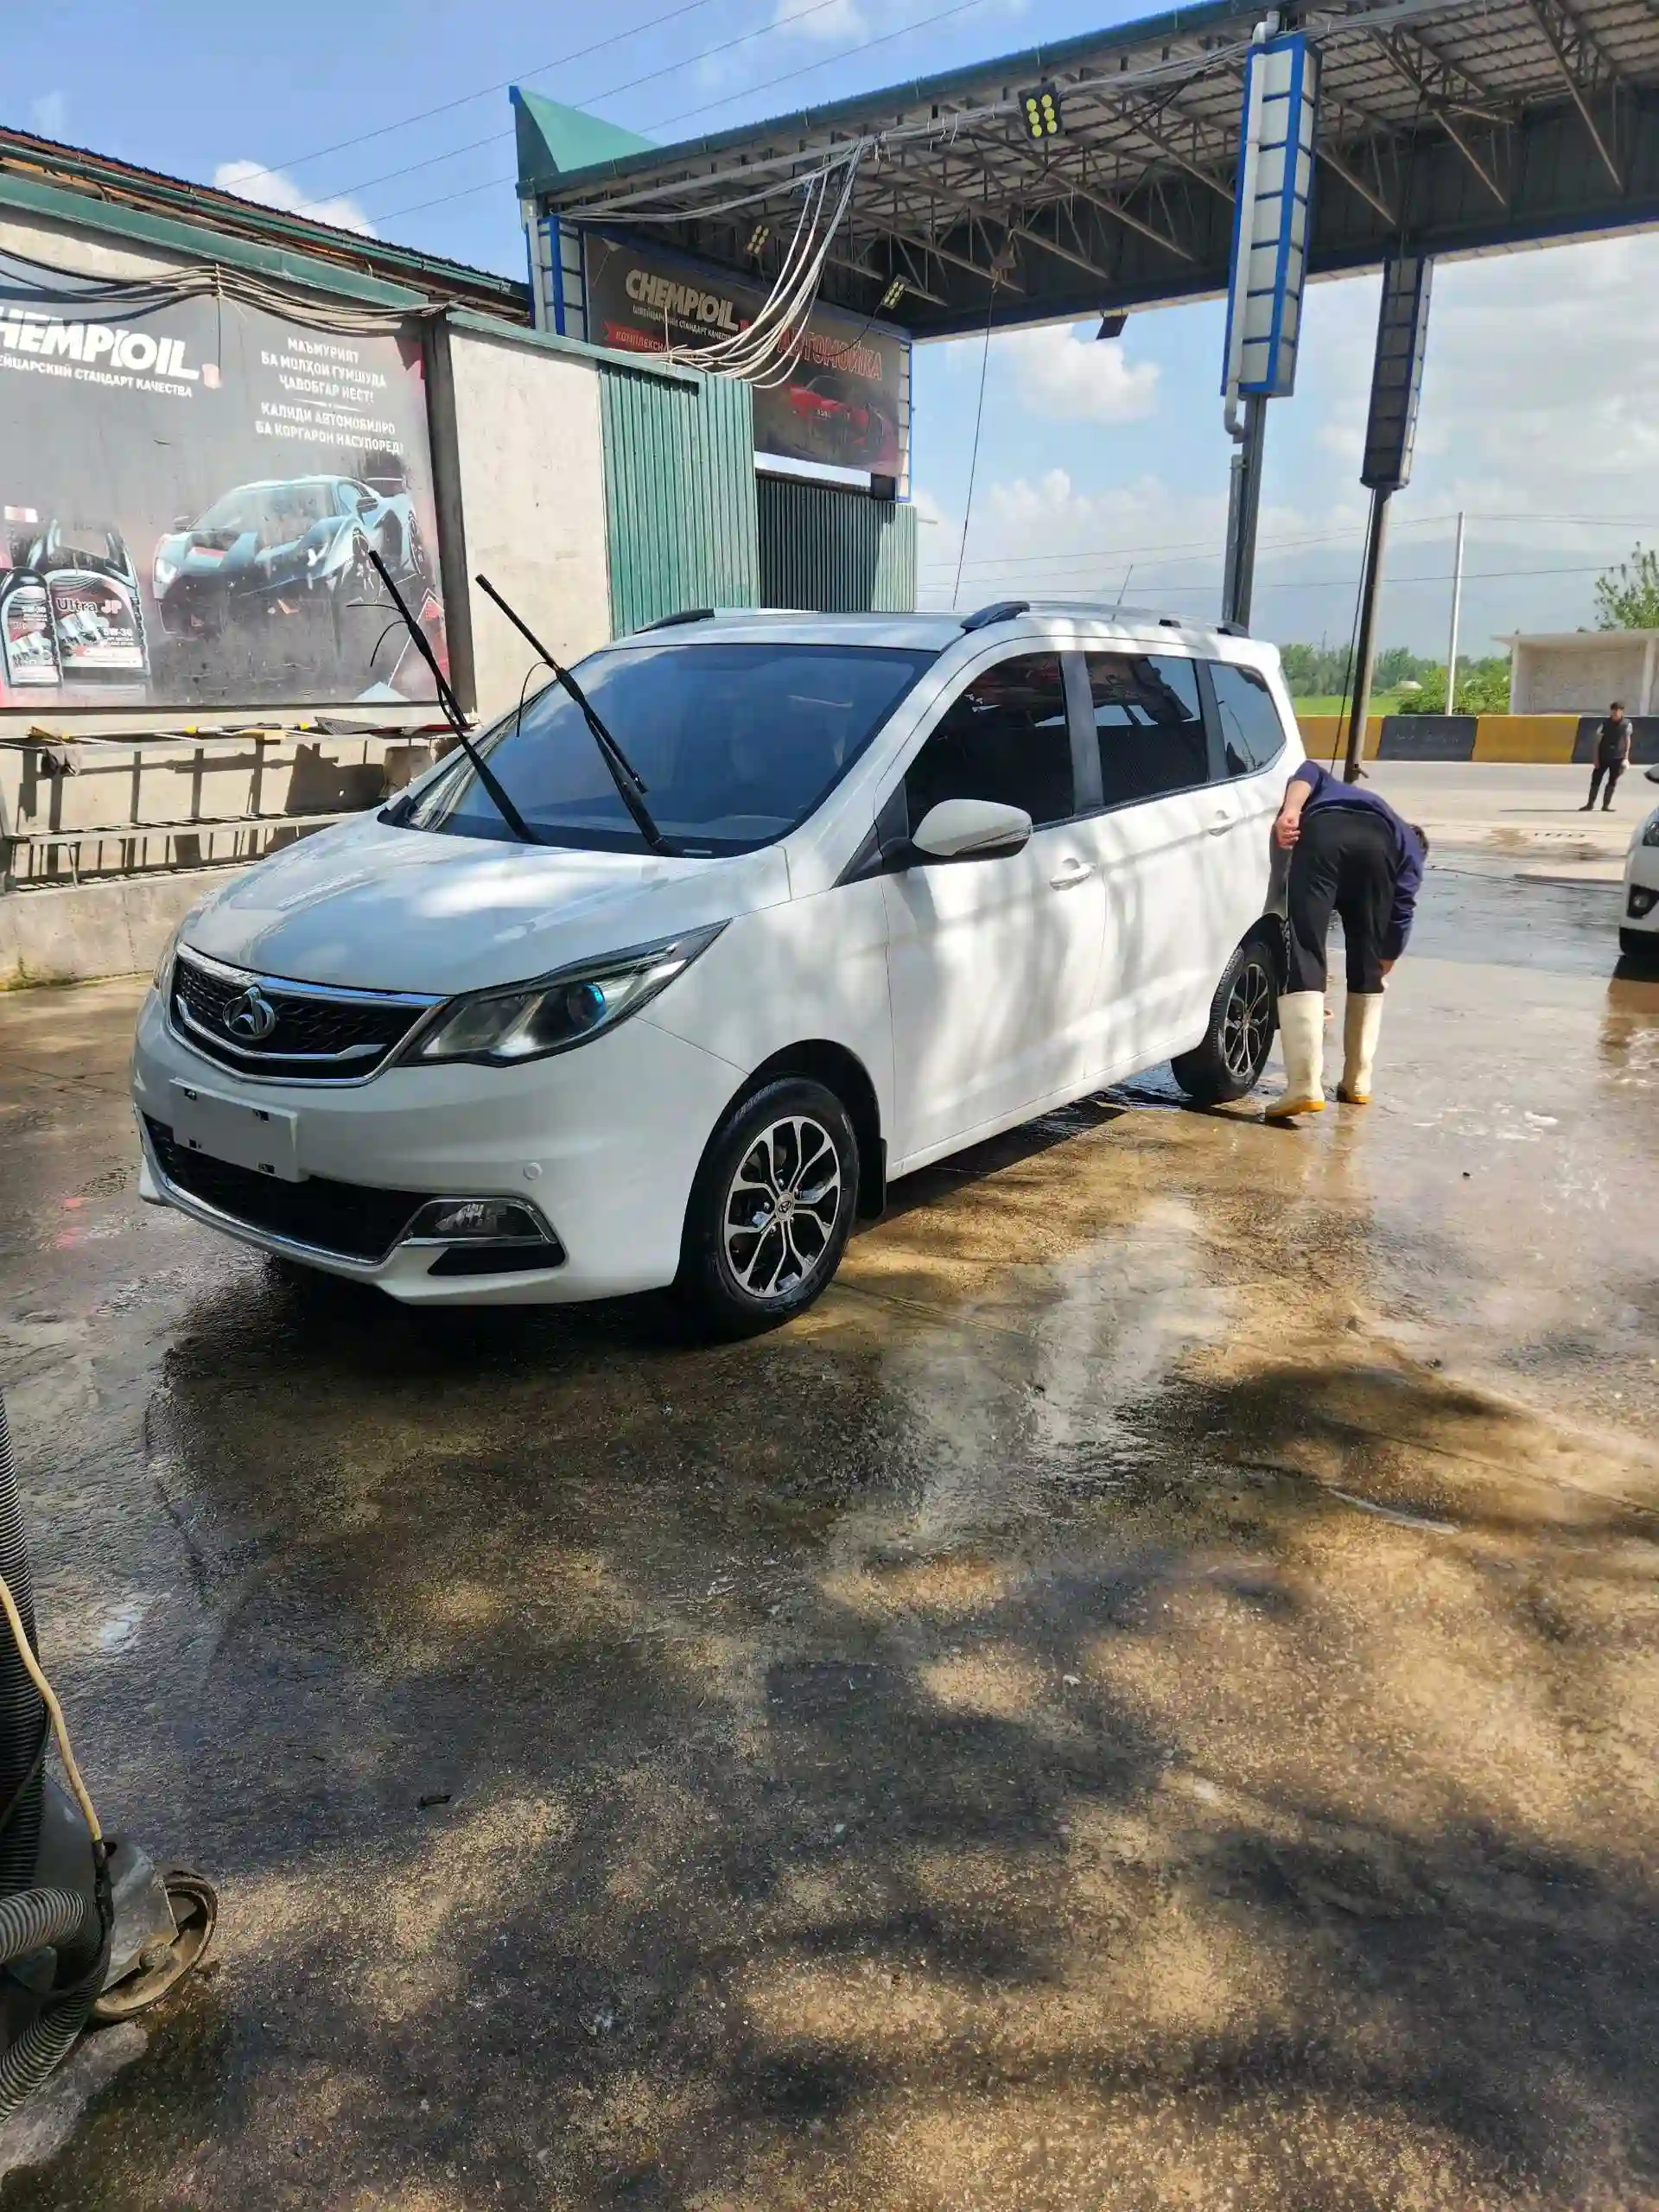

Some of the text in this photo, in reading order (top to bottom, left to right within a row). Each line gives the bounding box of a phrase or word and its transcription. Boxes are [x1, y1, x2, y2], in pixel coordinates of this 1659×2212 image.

[626, 269, 739, 331] CHEMPIOIL
[678, 320, 708, 336] СТАНДАРТ
[288, 337, 359, 364] МАЪМУРИЯТ
[74, 366, 135, 388] СТАНДАРТ
[136, 378, 193, 397] КАЧЕСТВА
[261, 351, 278, 366] БА
[332, 365, 387, 389] ГУМШУДА
[342, 389, 375, 405] НЕСТ!
[255, 420, 272, 434] БА
[274, 423, 334, 444] КОРГАРОН
[261, 402, 396, 435] КАЛИДИ АВТОМОБИЛРО
[55, 598, 123, 614] Ultra JP
